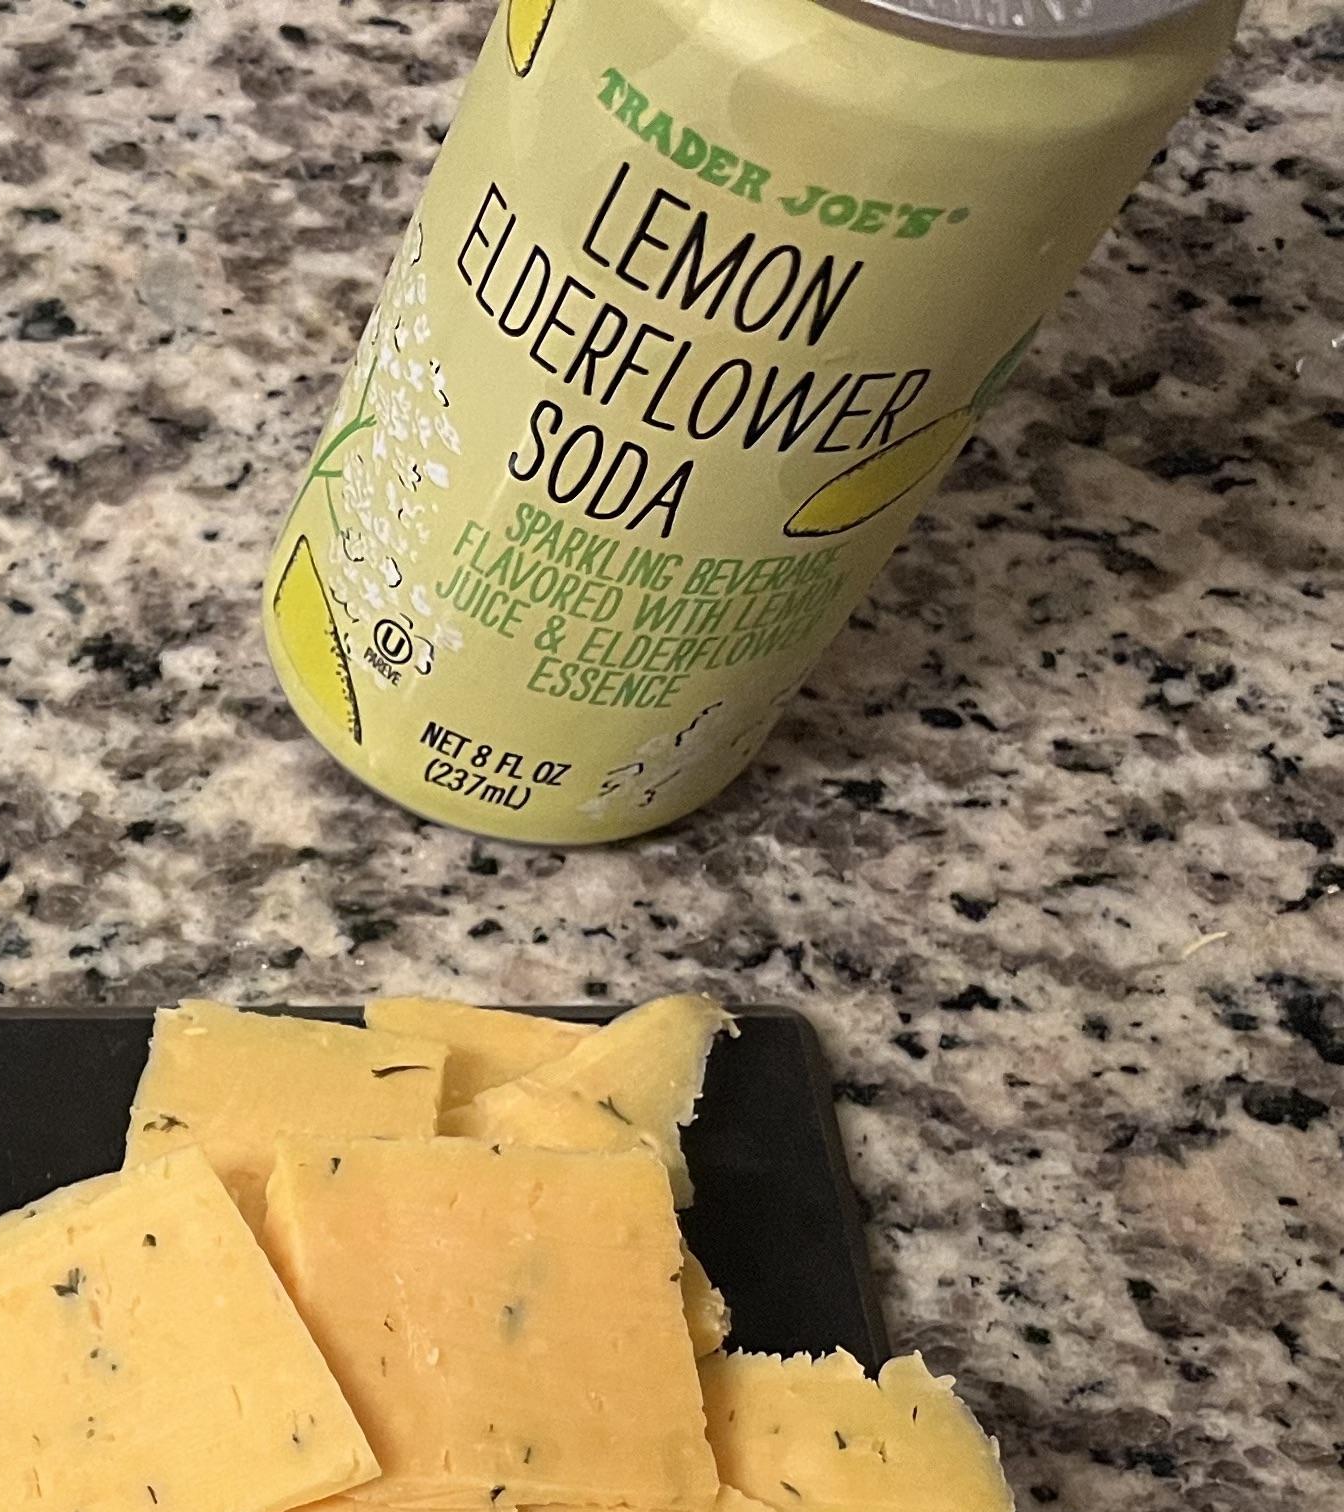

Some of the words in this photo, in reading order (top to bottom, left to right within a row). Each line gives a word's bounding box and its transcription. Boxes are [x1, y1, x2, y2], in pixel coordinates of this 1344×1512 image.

[596, 67, 772, 204] TRADER
[582, 161, 865, 347] LEMON
[457, 182, 931, 454] ELDERFLOWER
[508, 400, 695, 538] SODA
[452, 519, 624, 624] FLAVORED
[632, 592, 732, 635] WITH
[504, 502, 684, 593] SPARKLING
[434, 565, 531, 639] JUICE
[534, 614, 567, 654] &
[364, 647, 402, 687] PAREVE
[527, 656, 691, 709] ESSENCE
[420, 721, 472, 759] NET
[471, 744, 493, 768] 8
[494, 752, 524, 780] FL
[532, 761, 572, 786] OZ
[424, 758, 532, 811] (237mL)
